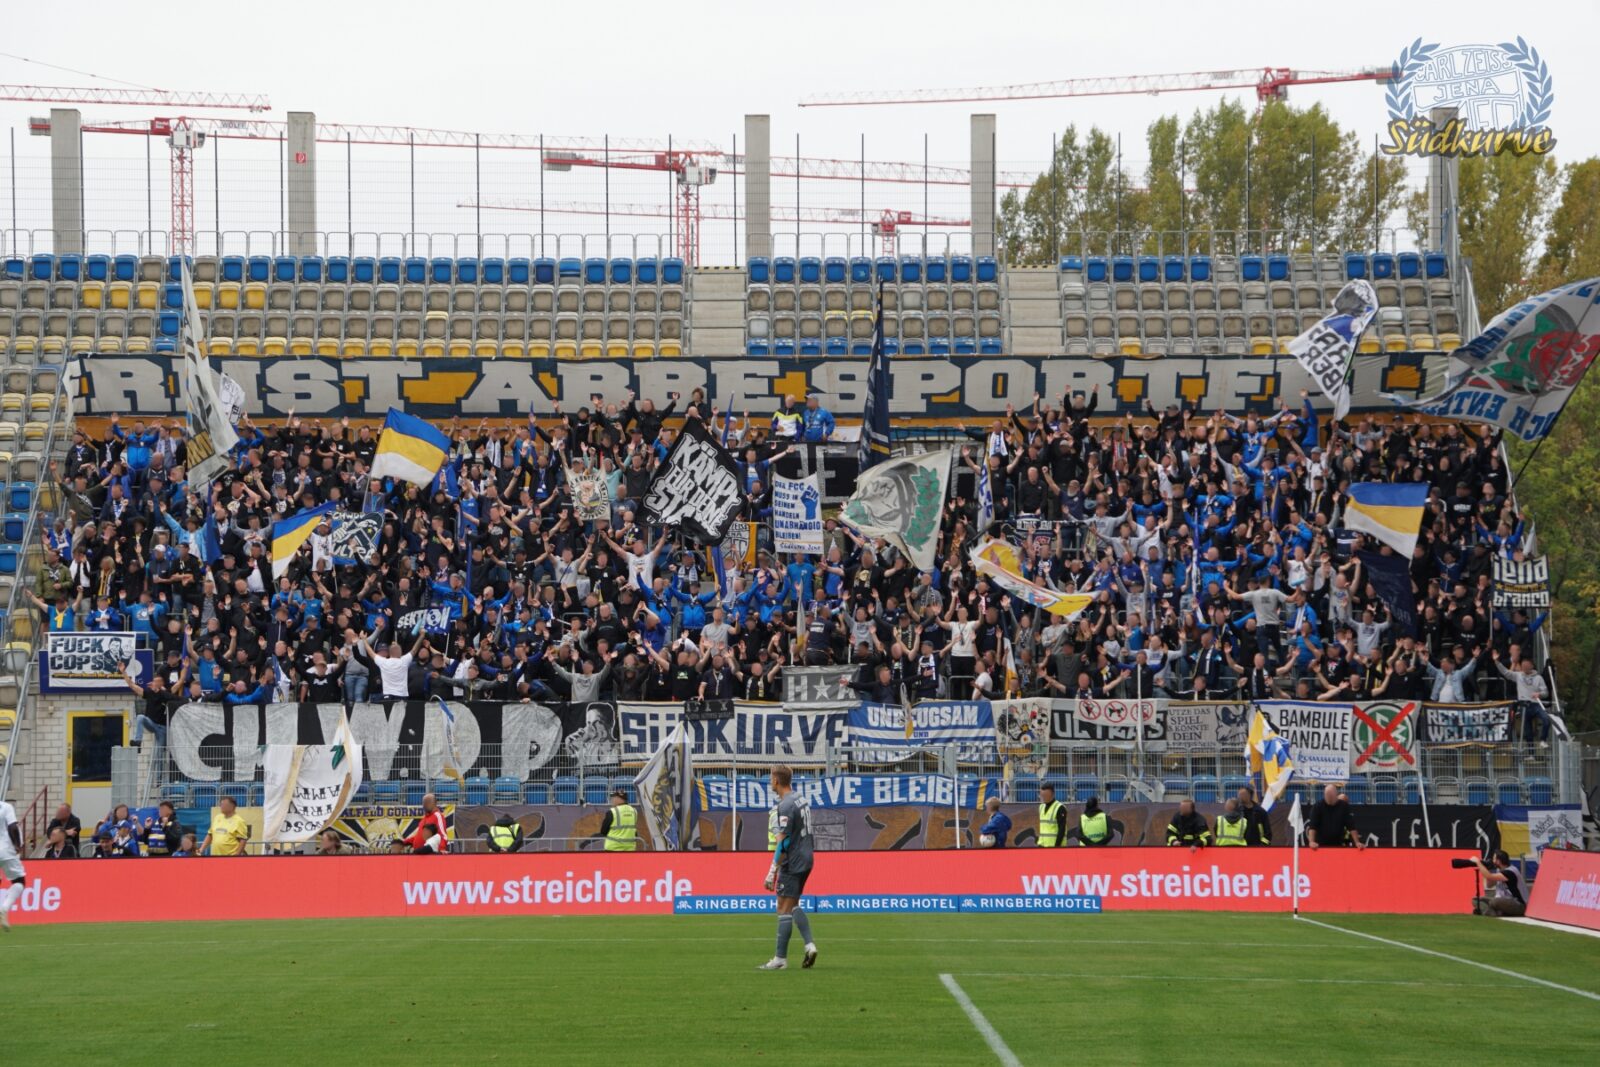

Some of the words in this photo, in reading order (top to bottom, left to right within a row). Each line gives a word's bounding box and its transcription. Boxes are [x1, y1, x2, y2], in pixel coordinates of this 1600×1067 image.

[461, 361, 779, 414] ABBE
[788, 482, 805, 491] FCC
[50, 637, 104, 653] FUCK
[50, 655, 104, 670] COPS
[1171, 716, 1204, 725] SPIEL
[1280, 709, 1350, 730] BAMBULE
[1427, 708, 1510, 725] REFUGEES
[1173, 731, 1202, 740] DEIN
[1428, 725, 1509, 742] WELCOME
[874, 776, 973, 807] BLEIBT
[403, 870, 692, 905] www.streicher.de
[1022, 866, 1311, 898] www.streicher.de
[695, 899, 766, 910] RINGBERG
[770, 899, 814, 909] HEL
[837, 898, 908, 909] RINGBERG
[911, 898, 956, 909] HOTEL
[980, 898, 1052, 909] RINGBERG
[1055, 898, 1100, 910] HOTEL
